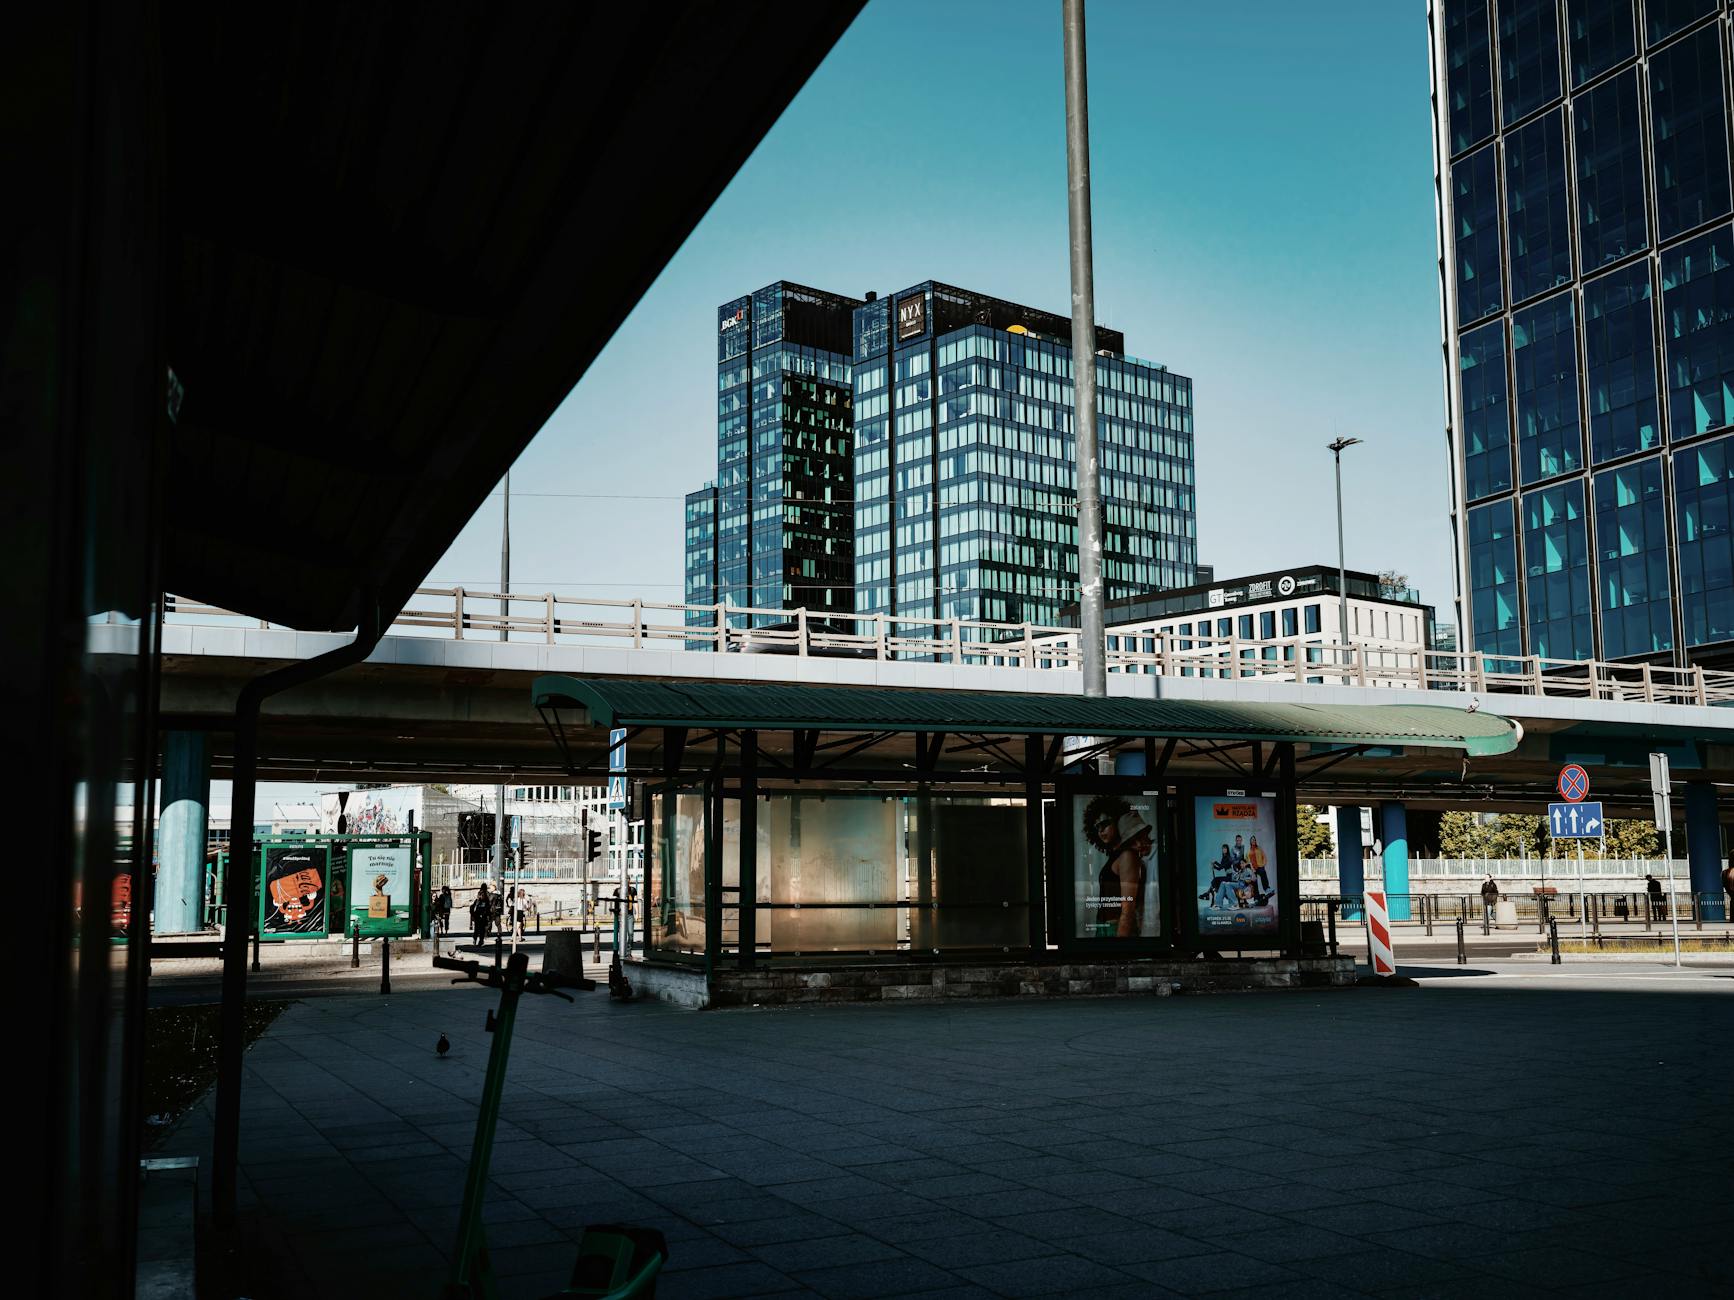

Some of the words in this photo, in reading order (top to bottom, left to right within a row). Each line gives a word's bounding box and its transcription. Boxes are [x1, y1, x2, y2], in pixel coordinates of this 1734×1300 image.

[901, 303, 921, 322] NYX
[721, 316, 737, 330] BGK
[1249, 581, 1272, 593] ZDROFIT
[1210, 593, 1222, 604] GT
